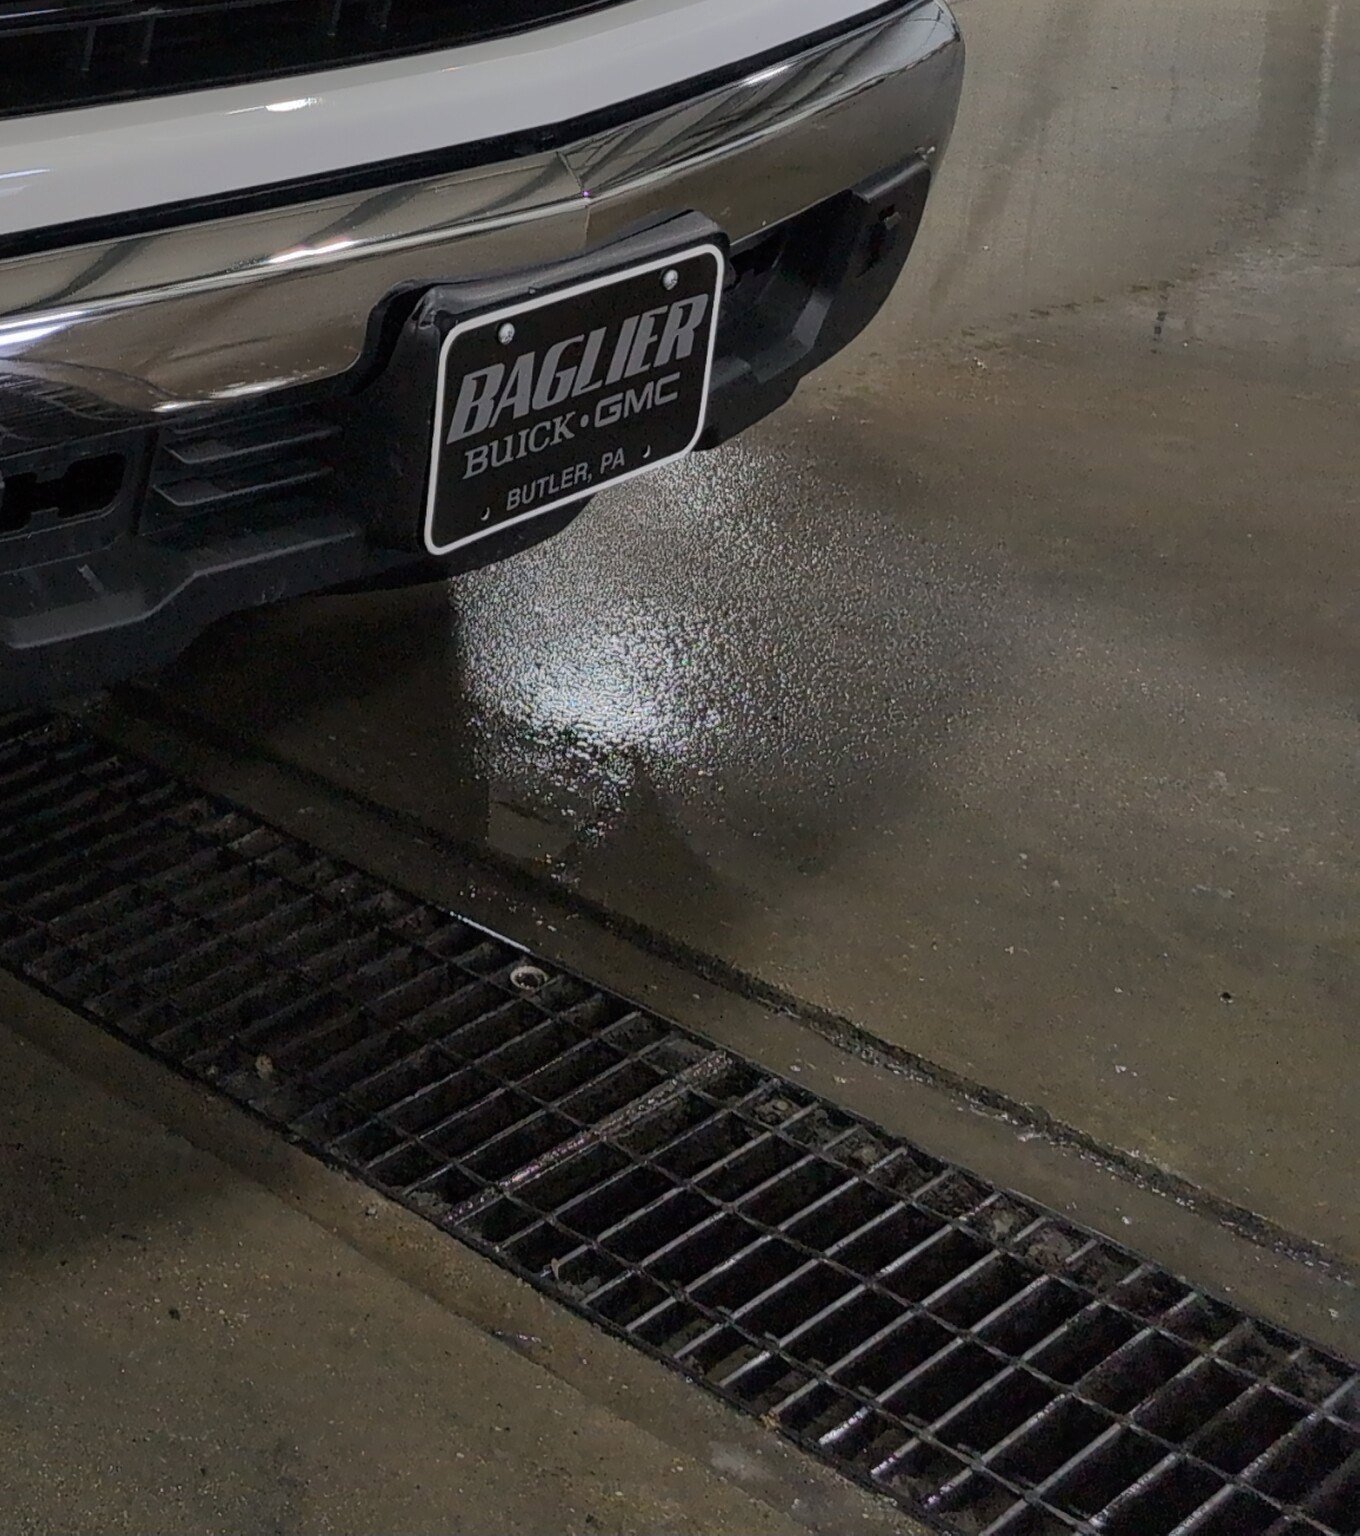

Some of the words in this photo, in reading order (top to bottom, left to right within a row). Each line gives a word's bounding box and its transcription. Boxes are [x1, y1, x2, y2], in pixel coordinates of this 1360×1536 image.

[446, 293, 709, 445] BAGLIER
[462, 411, 577, 480] BUICK
[593, 372, 681, 429] GMC
[505, 460, 593, 512] BUTLER,
[599, 447, 626, 475] PA
